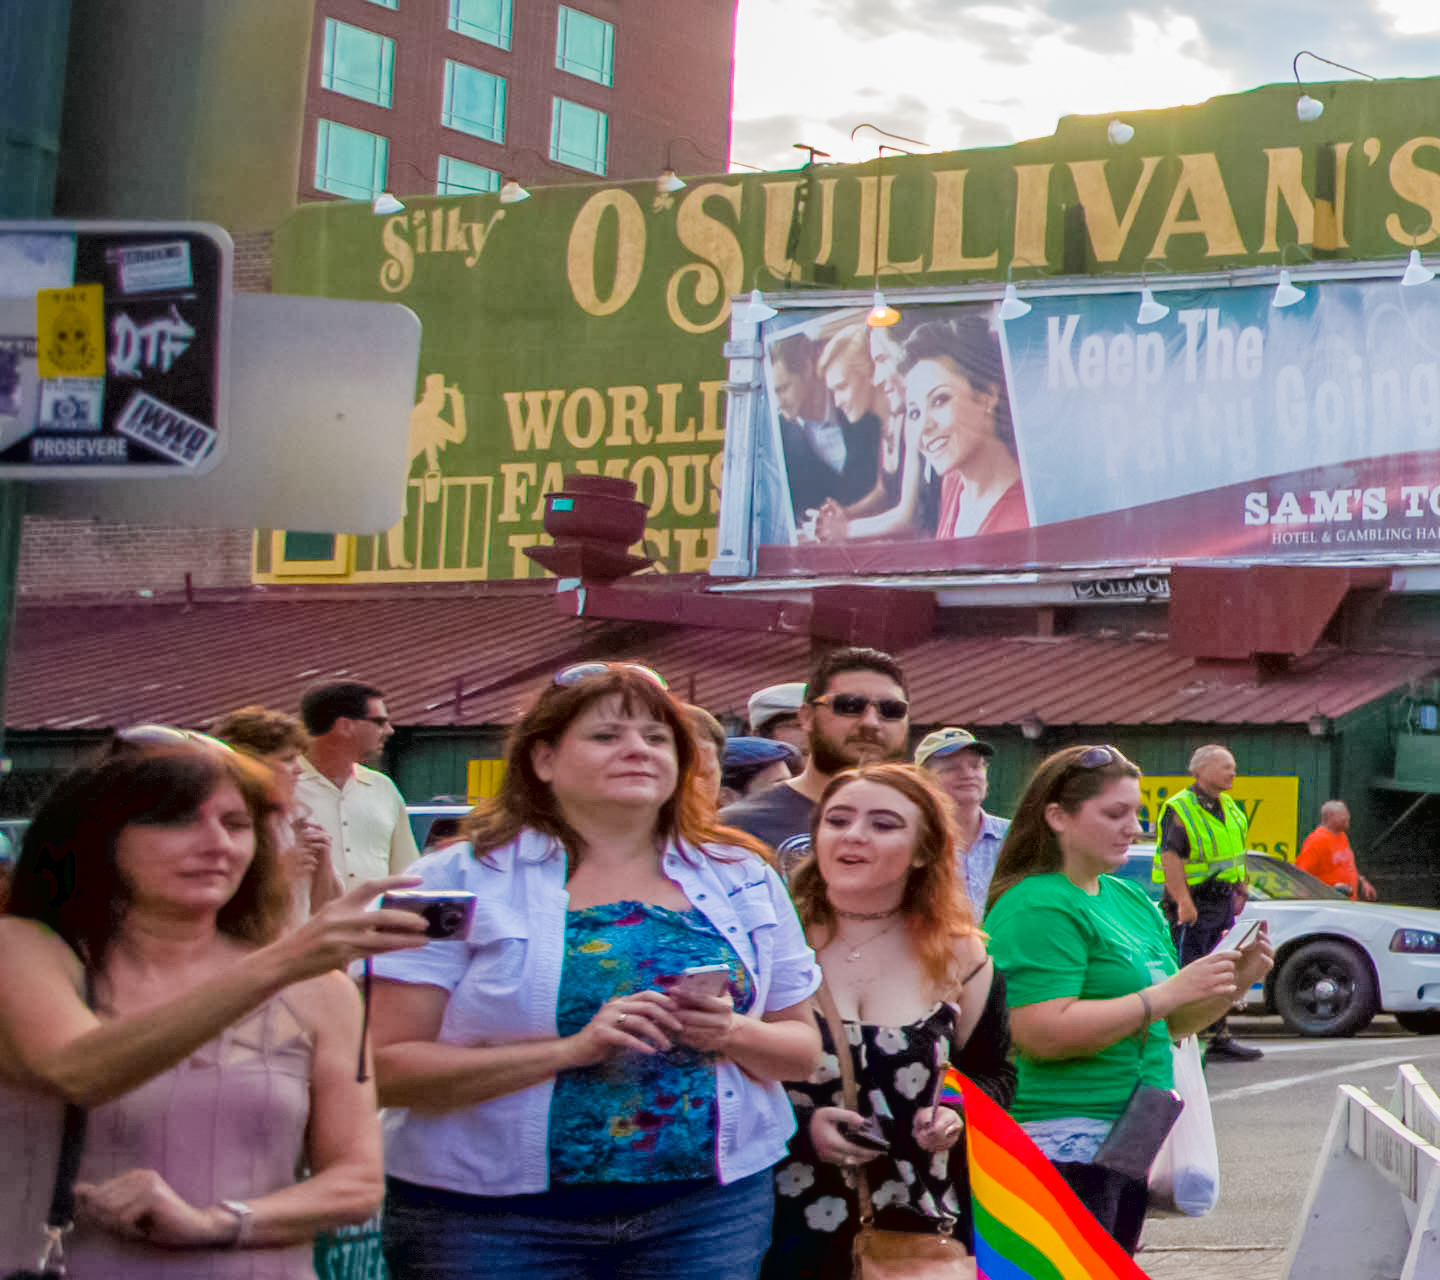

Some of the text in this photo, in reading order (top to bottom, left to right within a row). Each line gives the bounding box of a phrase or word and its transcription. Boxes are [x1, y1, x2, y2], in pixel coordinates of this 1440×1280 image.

[379, 208, 505, 293] Silky
[1047, 307, 1265, 406] Keep The
[33, 437, 128, 457] PROSEVERE
[1244, 486, 1388, 526] SAM'S
[1272, 528, 1318, 545] HOTEL
[1321, 529, 1332, 543] &
[1336, 526, 1412, 544] GAMBLING
